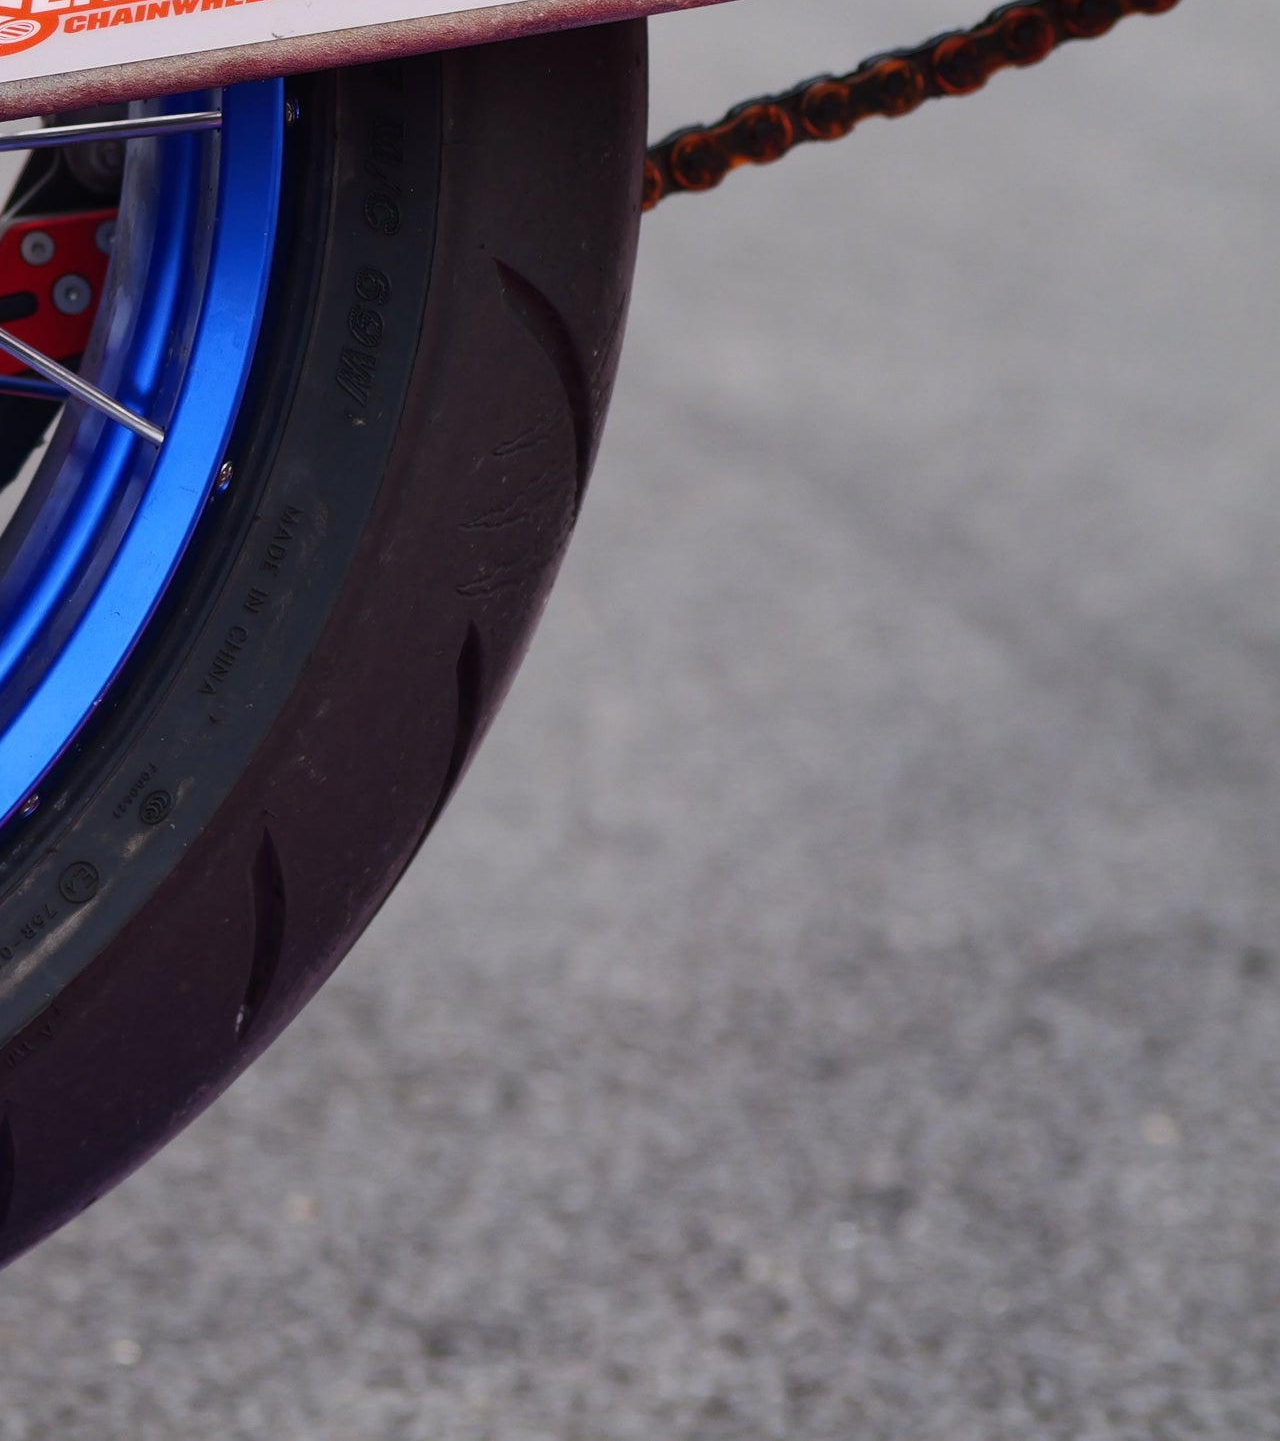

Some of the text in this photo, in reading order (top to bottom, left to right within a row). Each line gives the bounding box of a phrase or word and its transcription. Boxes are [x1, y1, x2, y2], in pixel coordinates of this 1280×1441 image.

[197, 504, 304, 695] MADE IN CHINA
